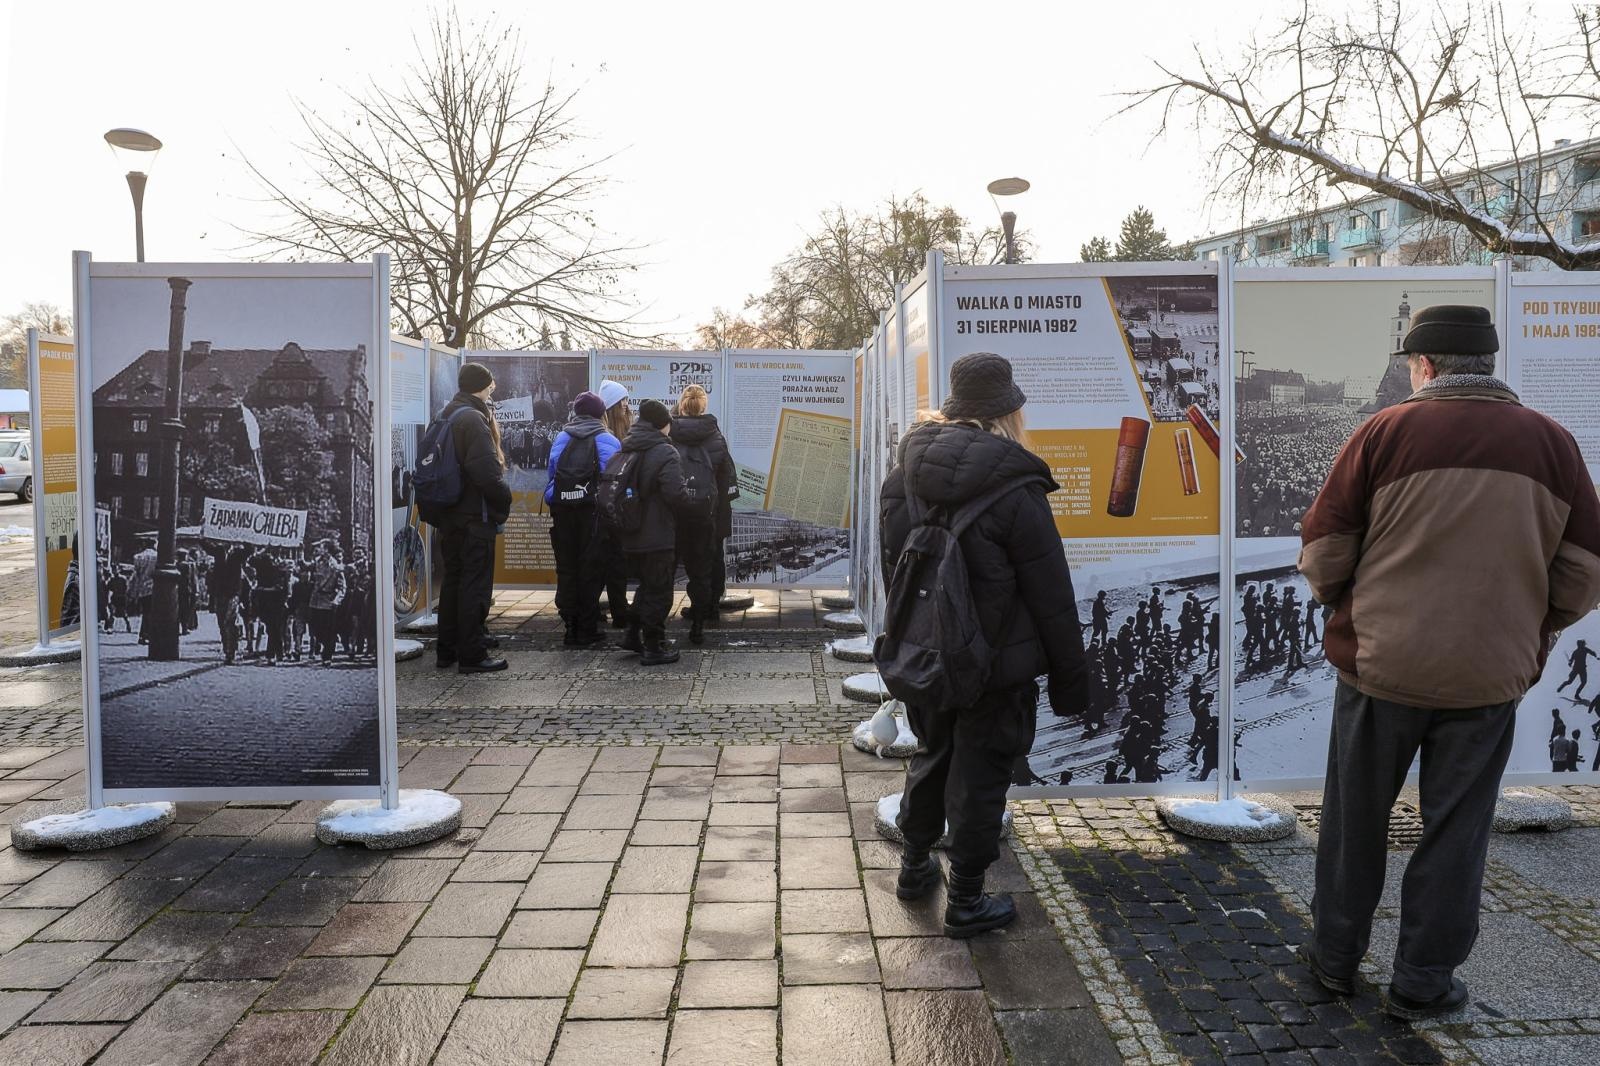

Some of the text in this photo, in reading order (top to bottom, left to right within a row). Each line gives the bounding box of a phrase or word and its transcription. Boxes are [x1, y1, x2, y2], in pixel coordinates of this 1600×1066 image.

[956, 295, 1082, 310] WALKA O MIASTO
[1523, 301, 1600, 315] POD TRYBU
[957, 319, 1077, 334] 31 SIERPNIA 1982
[1522, 325, 1528, 338] 1
[1532, 325, 1570, 338] MAJA
[62, 351, 74, 361] FEST
[608, 364, 625, 373] WIĘC
[669, 361, 713, 375] PZPR
[608, 374, 642, 382] WŁASNYM
[803, 376, 846, 384] NAJWIĘKSZA
[782, 384, 813, 393] PORAŻKA
[804, 396, 845, 404] WOJENNEGO
[561, 489, 585, 500] PUMA
[209, 503, 299, 539] ŻĄDAMY CHLEBA
